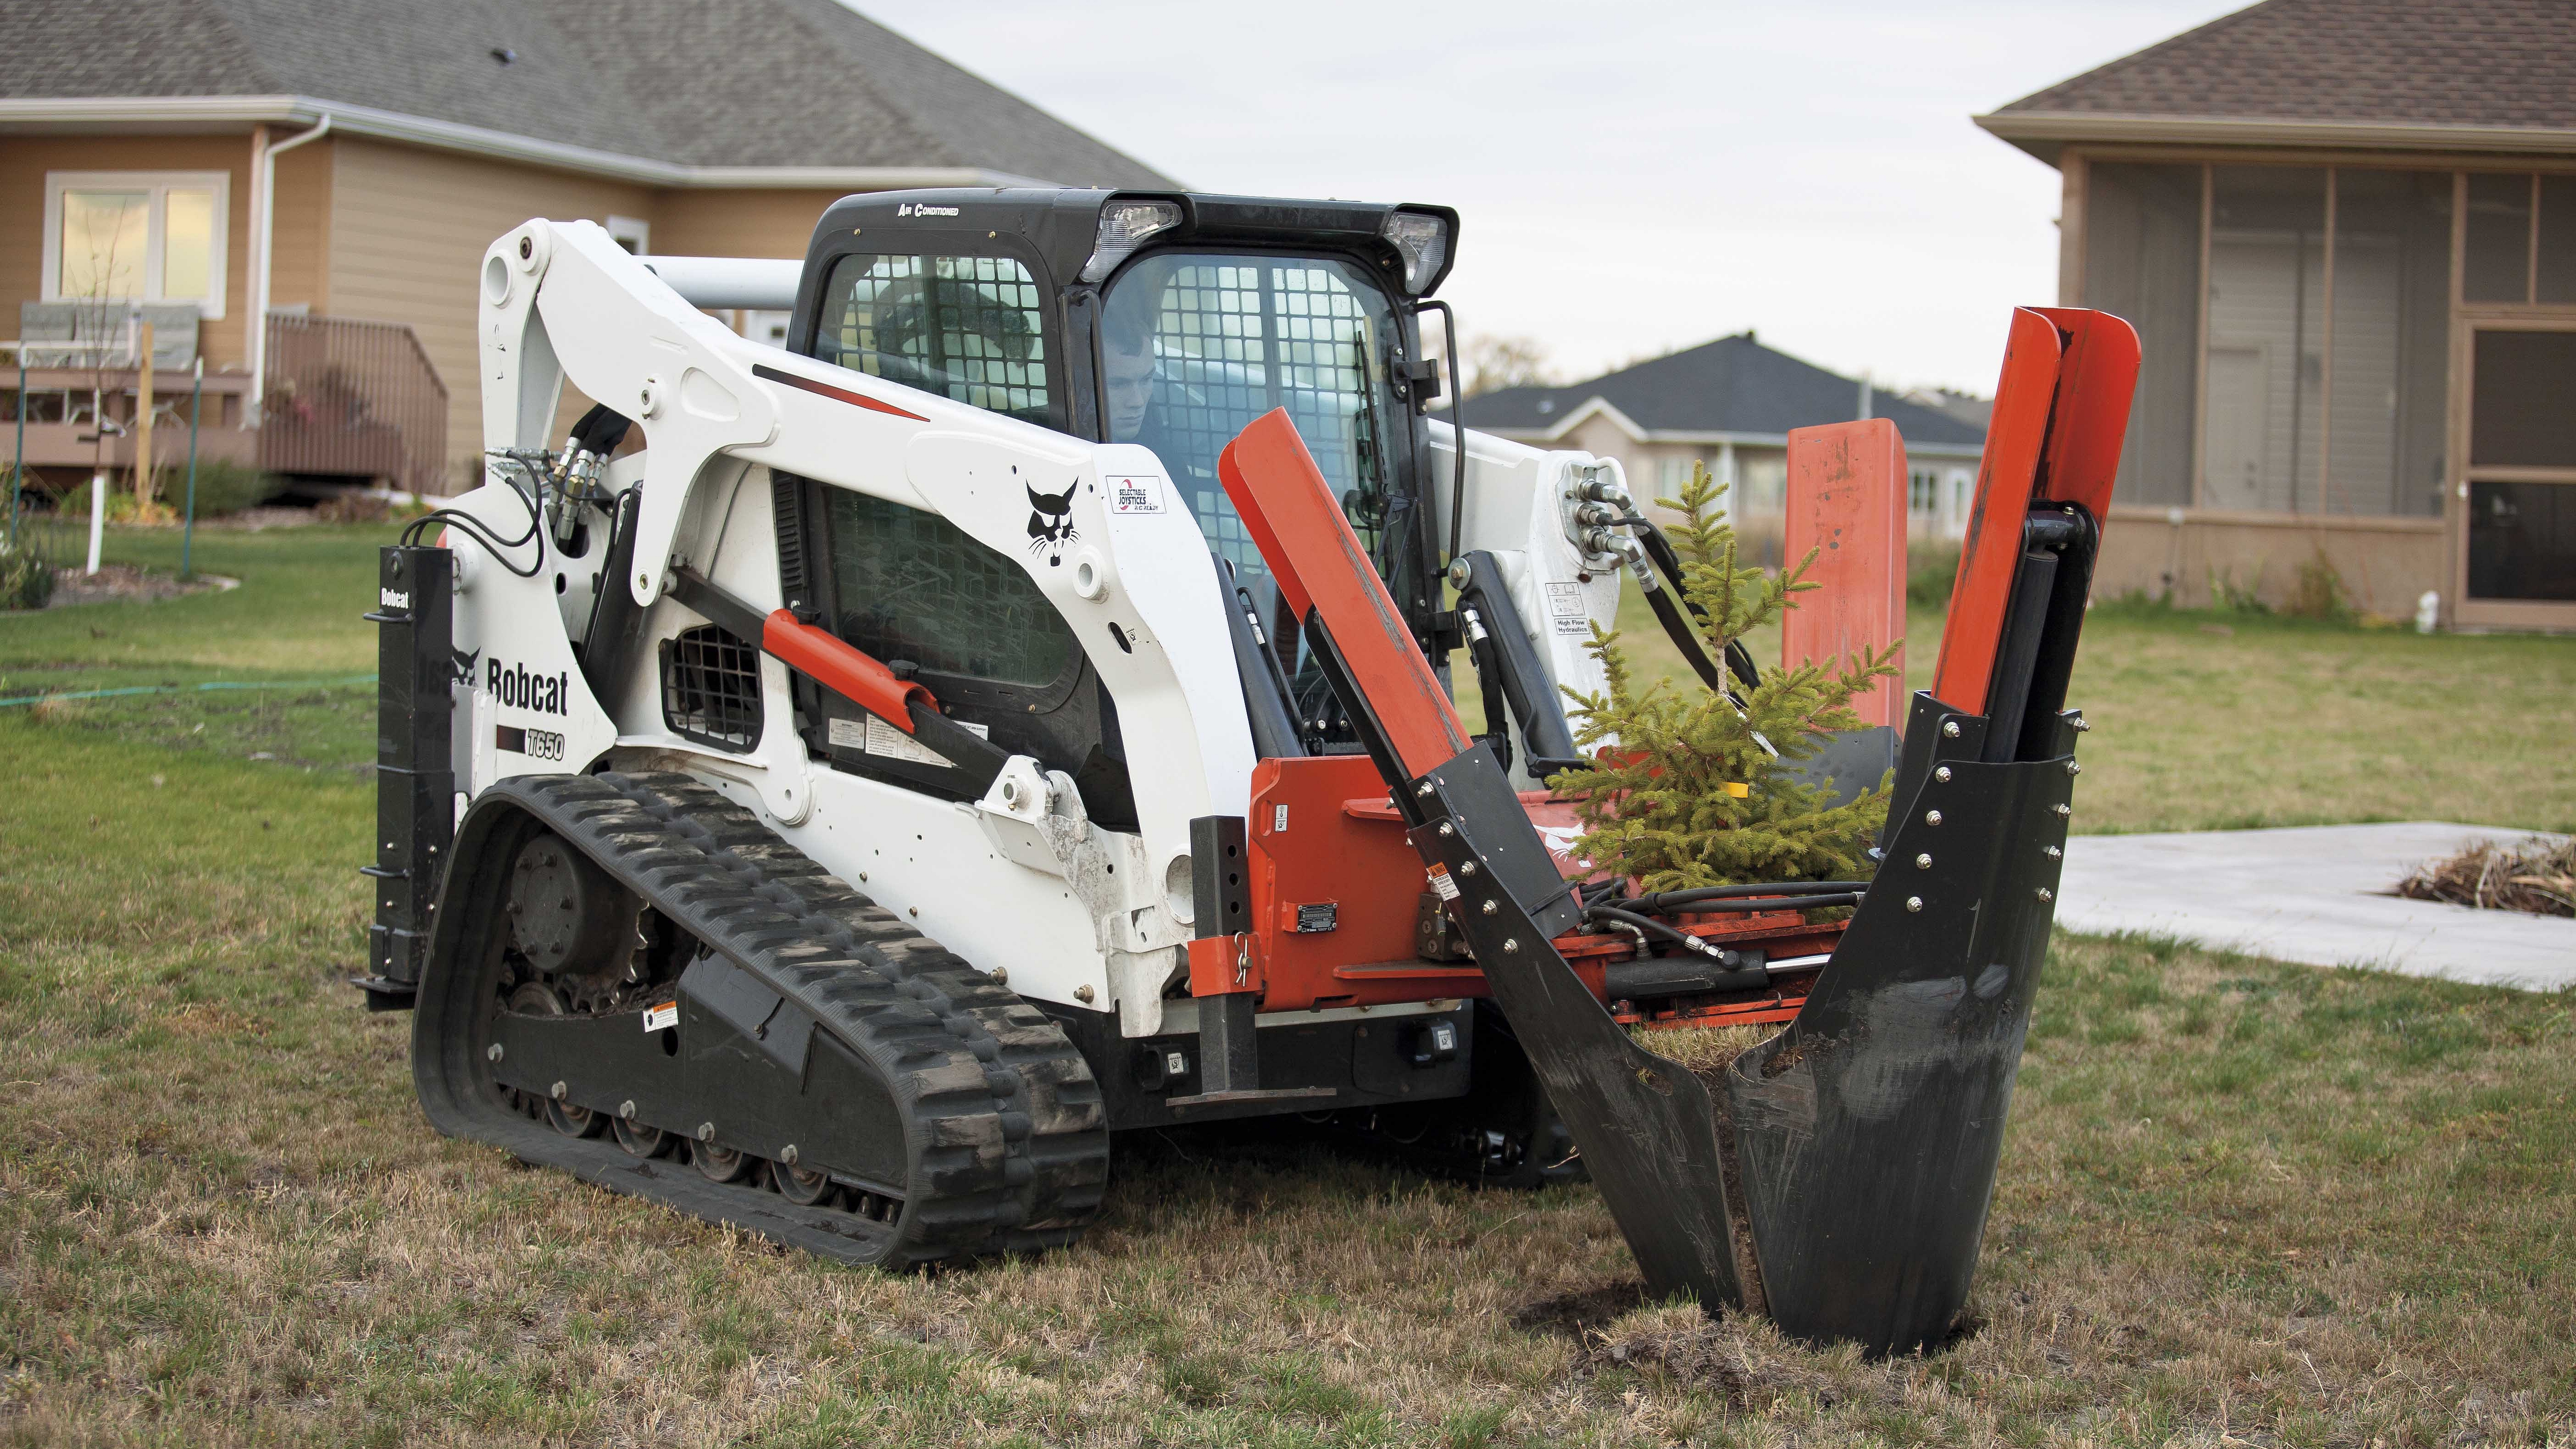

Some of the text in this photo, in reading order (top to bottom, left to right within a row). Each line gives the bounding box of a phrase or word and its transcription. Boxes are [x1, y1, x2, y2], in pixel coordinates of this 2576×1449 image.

[1119, 496, 1146, 505] JOYSTICKS
[381, 587, 409, 609] Bobcat
[487, 657, 568, 717] Bobcat
[528, 728, 565, 762] T650
